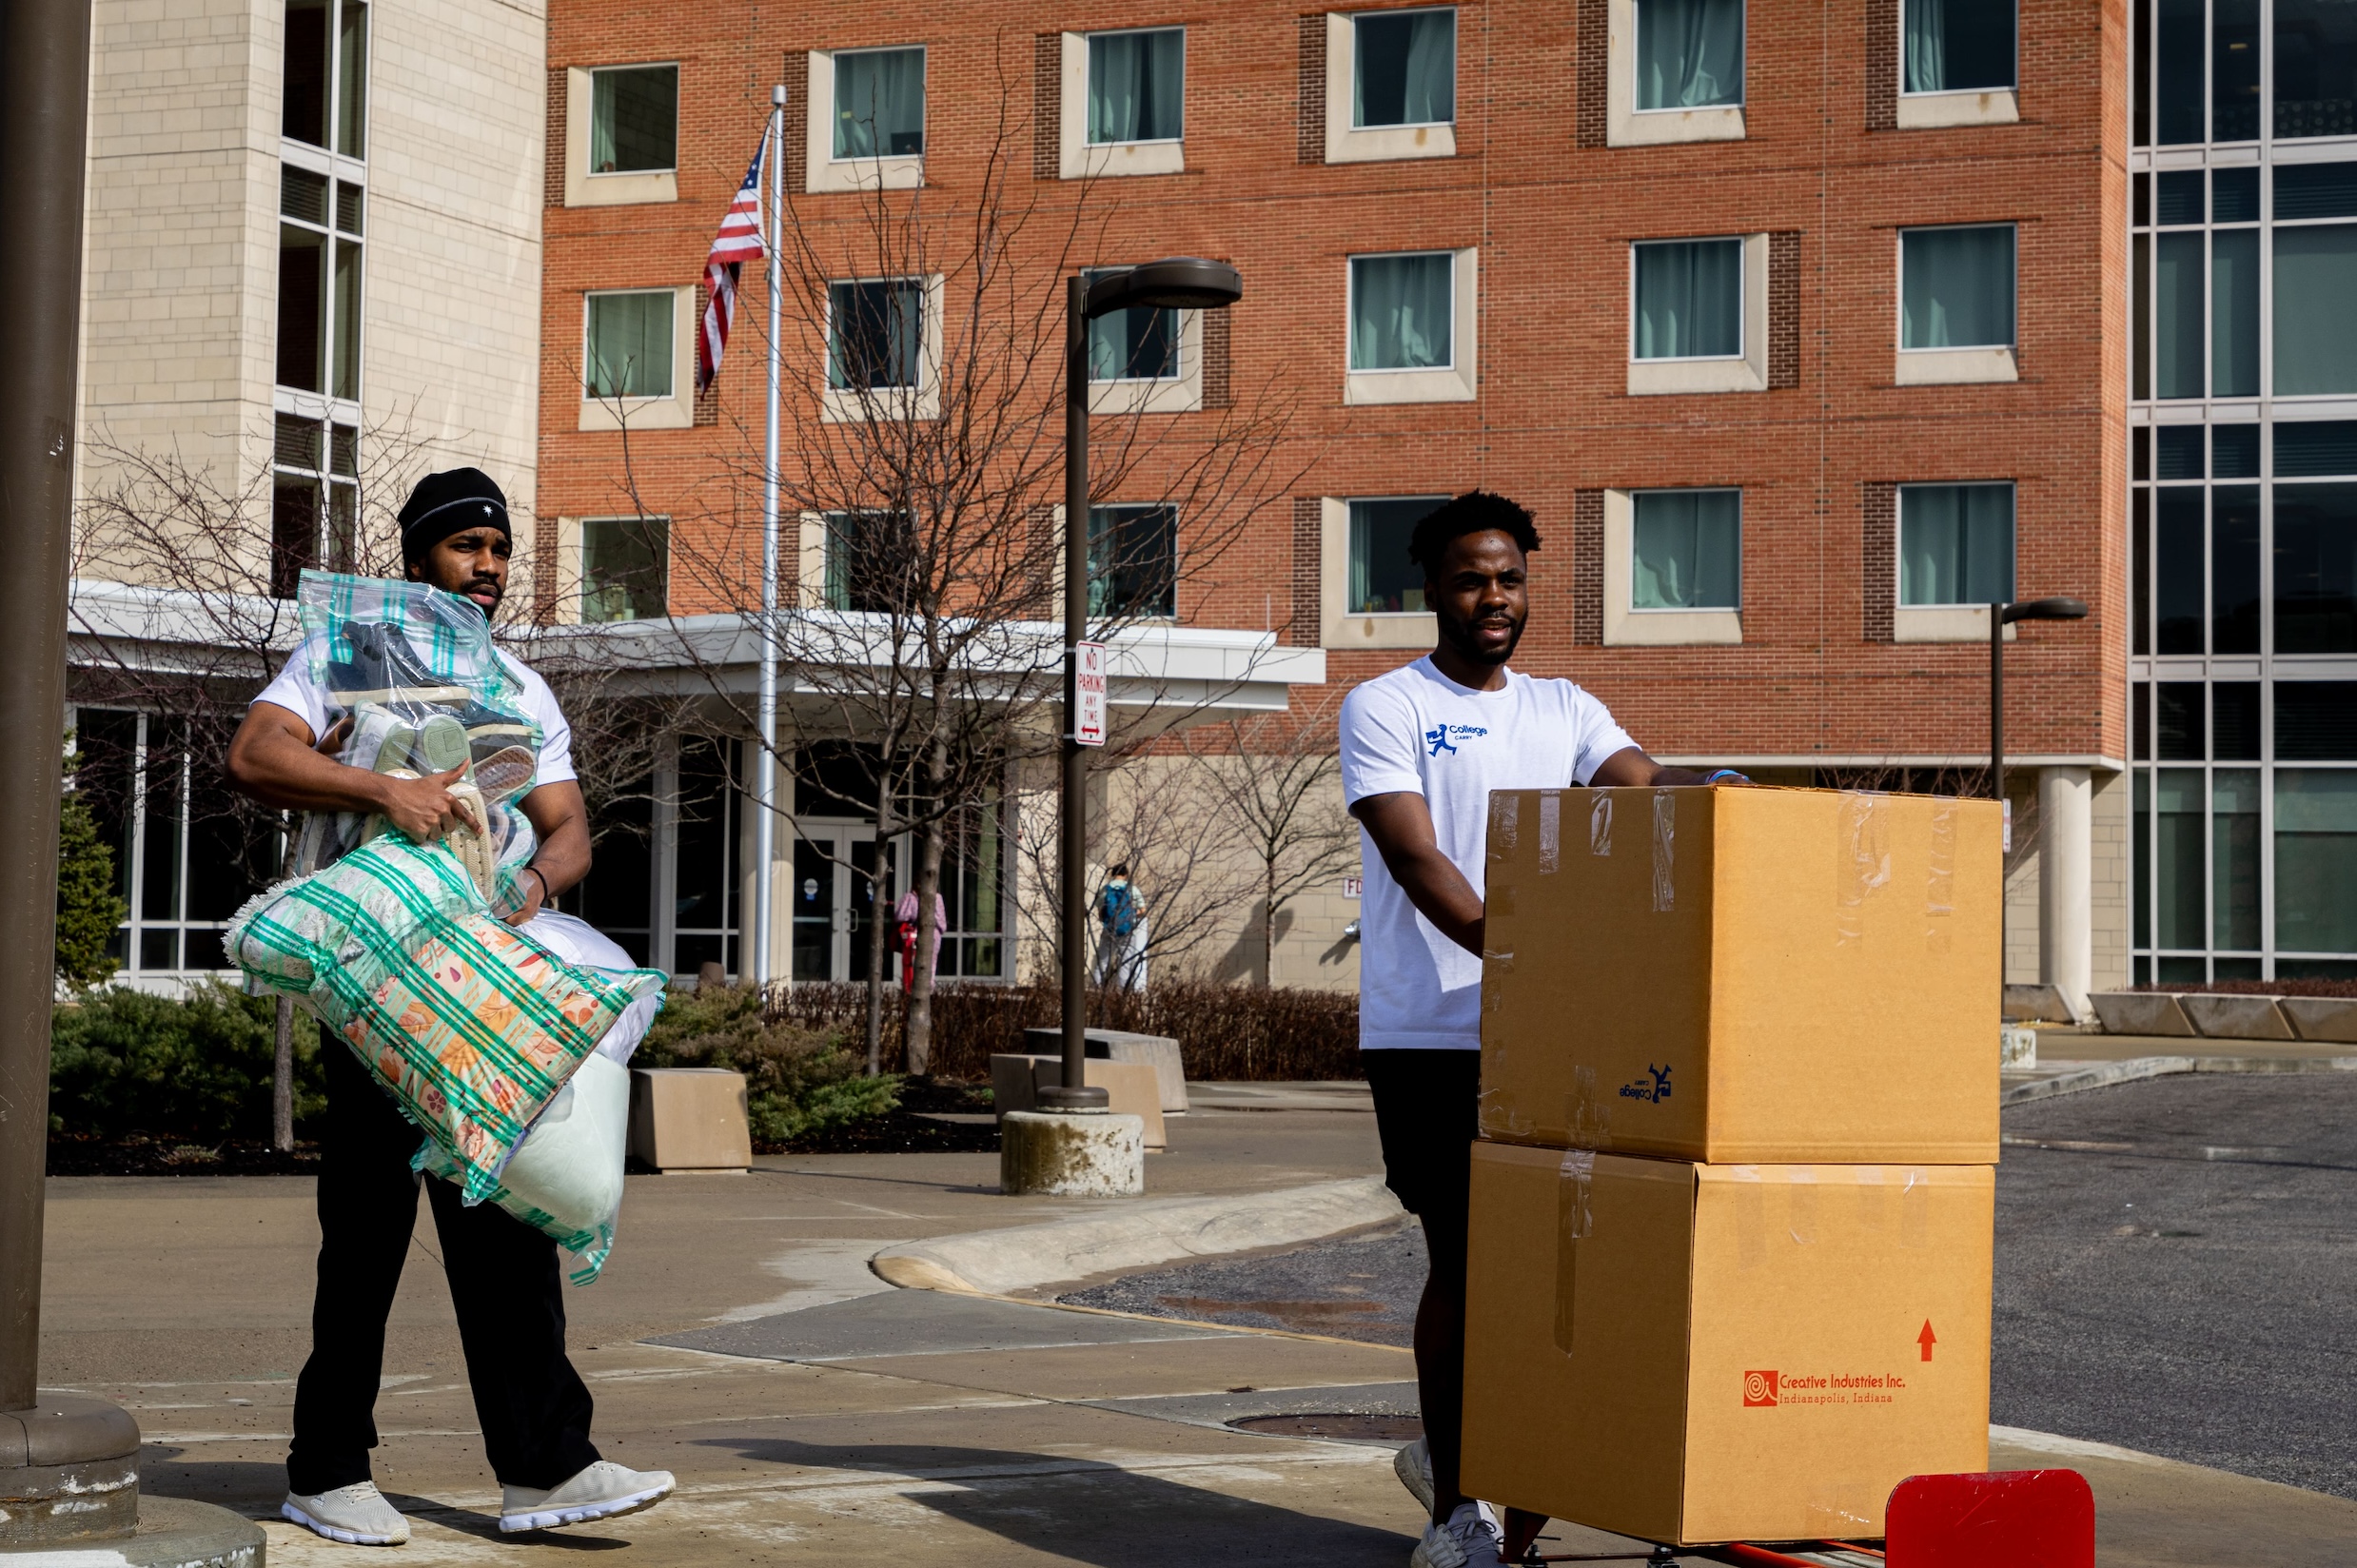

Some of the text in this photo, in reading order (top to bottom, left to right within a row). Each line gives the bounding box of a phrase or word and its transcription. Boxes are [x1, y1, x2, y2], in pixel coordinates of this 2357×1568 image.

[1086, 652, 1097, 671] NO
[1078, 673, 1105, 694] PARKING
[1086, 695, 1097, 708] ANY
[1084, 709, 1097, 723] TIME
[1449, 725, 1487, 736] College
[1620, 1084, 1651, 1100] College
[1779, 1373, 1906, 1389] Creative Industries Inc.
[1779, 1392, 1893, 1405] Indianapolis, Indiana
